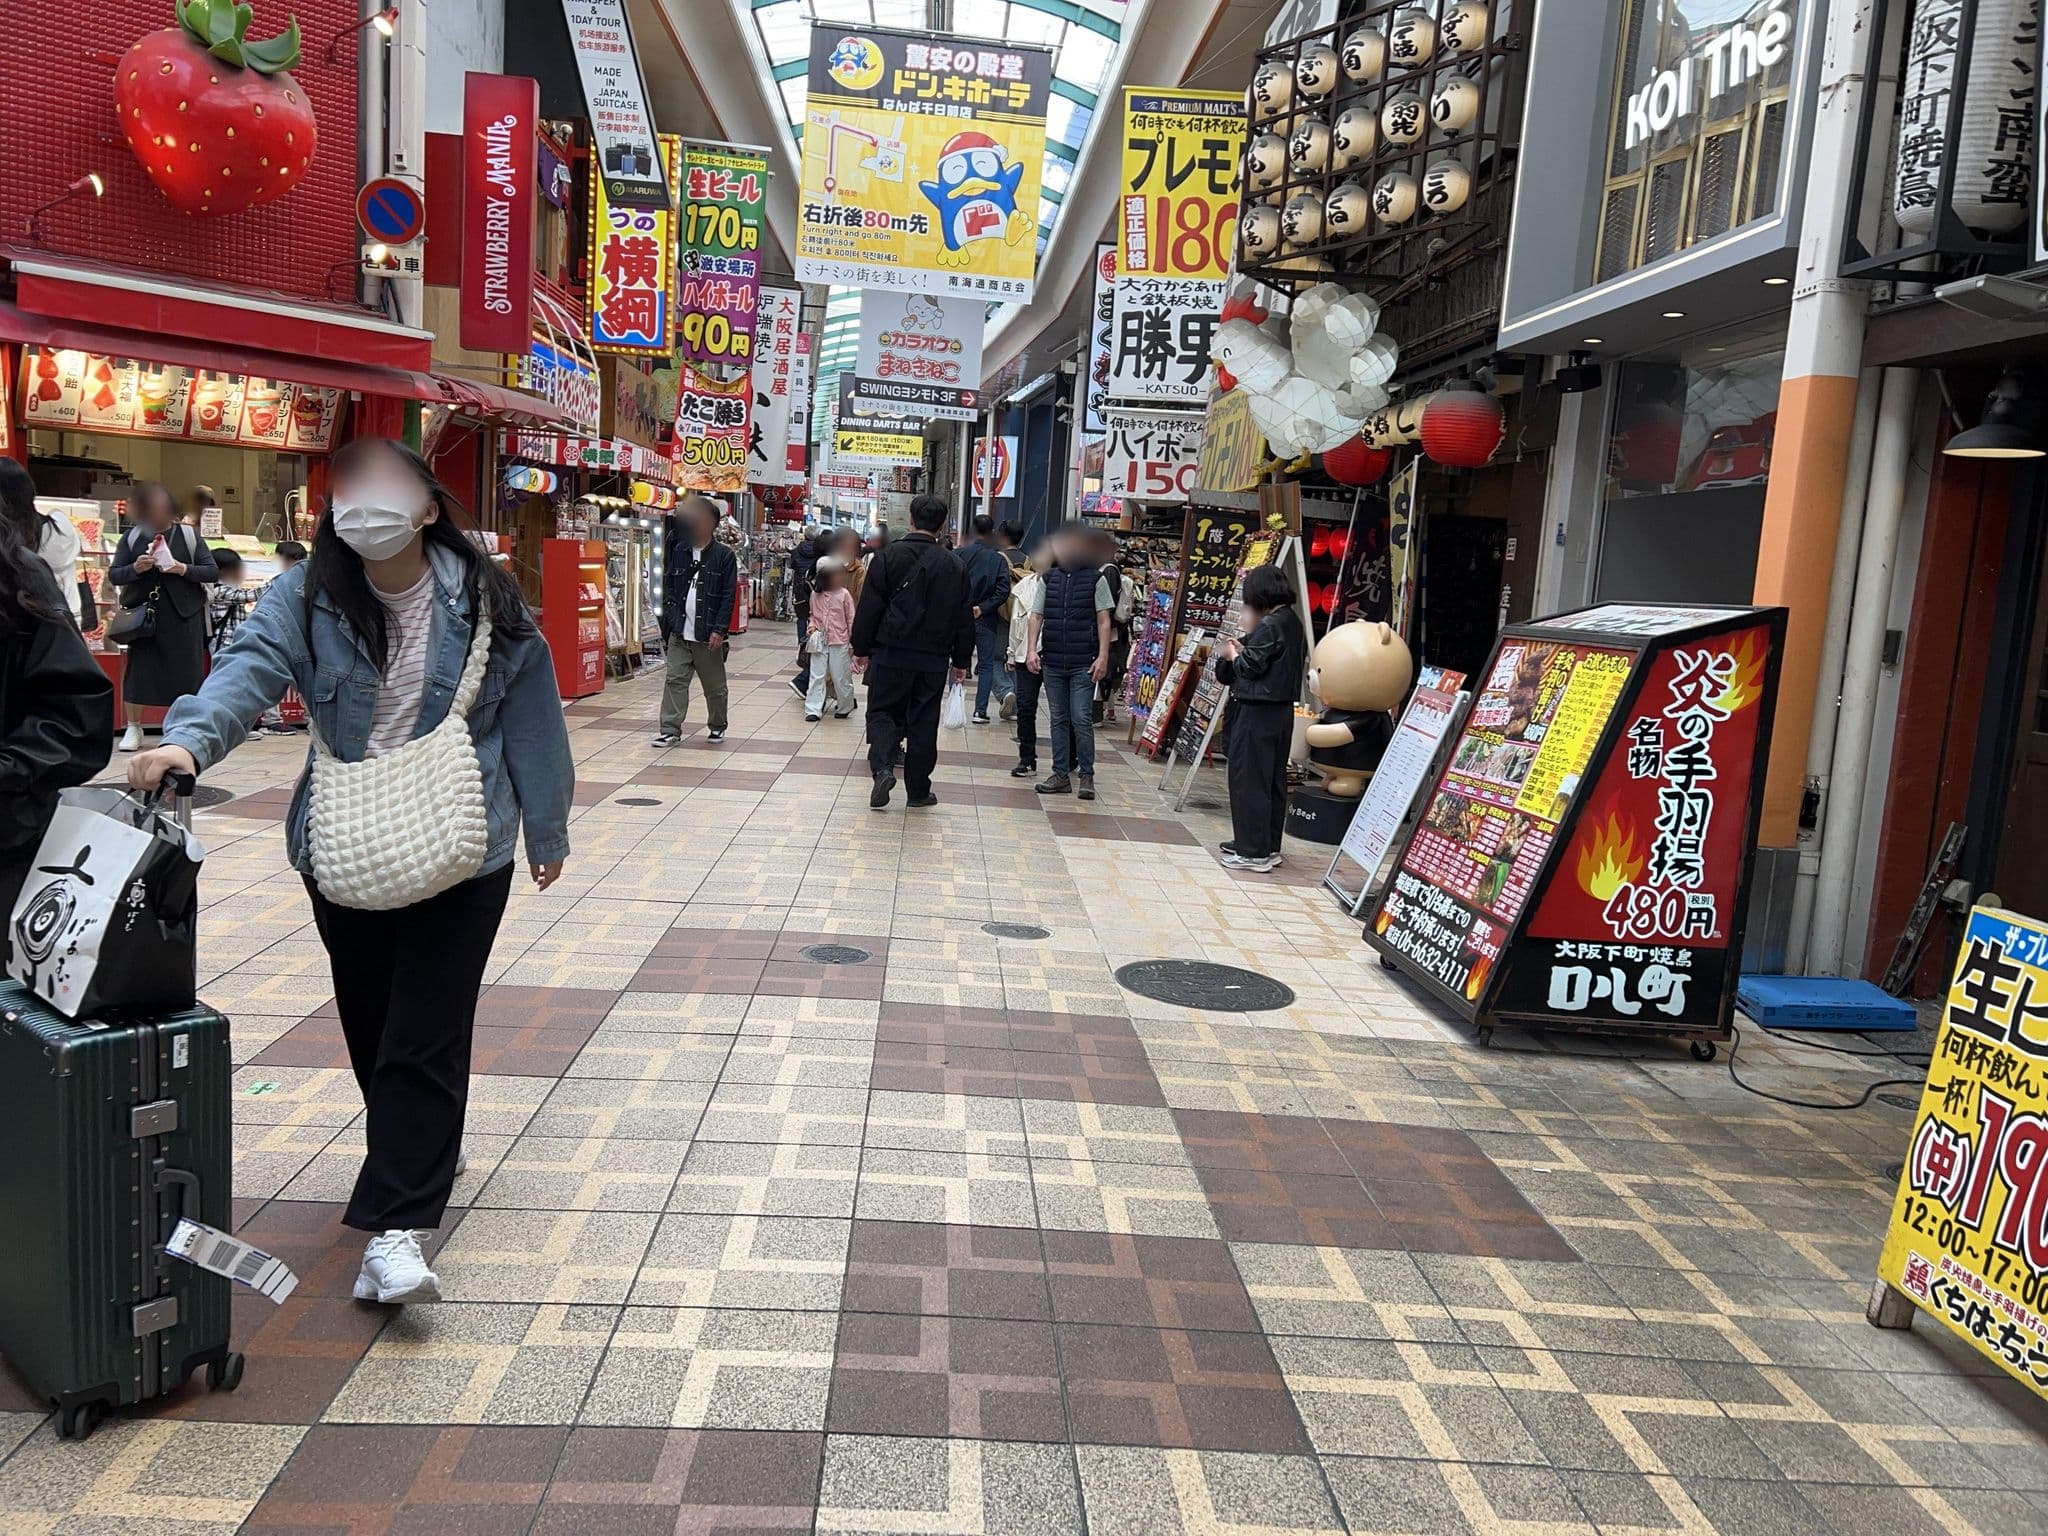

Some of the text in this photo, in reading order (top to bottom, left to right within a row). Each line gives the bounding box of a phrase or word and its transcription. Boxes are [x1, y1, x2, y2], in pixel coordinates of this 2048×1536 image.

[571, 15, 621, 28] 1DAY TOUR
[590, 6, 598, 14] &
[594, 67, 622, 77] MADE
[905, 43, 1024, 80] 驚安の殿堂
[599, 88, 628, 98] JAPAN
[606, 79, 615, 87] IN
[593, 98, 639, 110] SUITCASE
[883, 98, 972, 119] なんば千日前店
[1161, 101, 1202, 113] PREMIUM
[1204, 102, 1237, 115] MALT'S
[1896, 0, 1963, 211] 阪下町焼鳥
[625, 186, 662, 196] MARUWA
[686, 167, 762, 205] 生ビール
[485, 114, 517, 314] STRAWBERRY MANIA
[686, 202, 759, 251] 170円
[803, 202, 928, 235] 右折後80m先
[803, 225, 891, 240] Turn right and go 80m
[1126, 197, 1146, 269] 適正価格
[601, 234, 659, 342] 横綱
[683, 280, 755, 313] ハイボール
[948, 276, 1025, 293] 南海通商店会
[1127, 292, 1218, 310] と鉄板焼
[683, 312, 750, 357] 90円
[769, 296, 796, 396] 大阪居酒屋
[890, 330, 951, 353] カラオケ
[876, 351, 962, 384] まねきねこ
[165, 388, 178, 416] ソフト
[222, 390, 234, 417] ソフト
[278, 382, 292, 426] スムージー
[859, 382, 957, 402] SWINGヨシモト3F
[680, 391, 747, 428] たこ焼き
[840, 417, 920, 430] DINING DARTS BAR
[1107, 431, 1199, 461] ハイボー
[1184, 609, 1226, 623] ご予約承
[1628, 718, 1665, 780] 名物
[1604, 885, 1717, 940] 480円
[1555, 941, 1692, 968] 大阪下町焼鳥
[1941, 1025, 2048, 1099] 何杯飲ん
